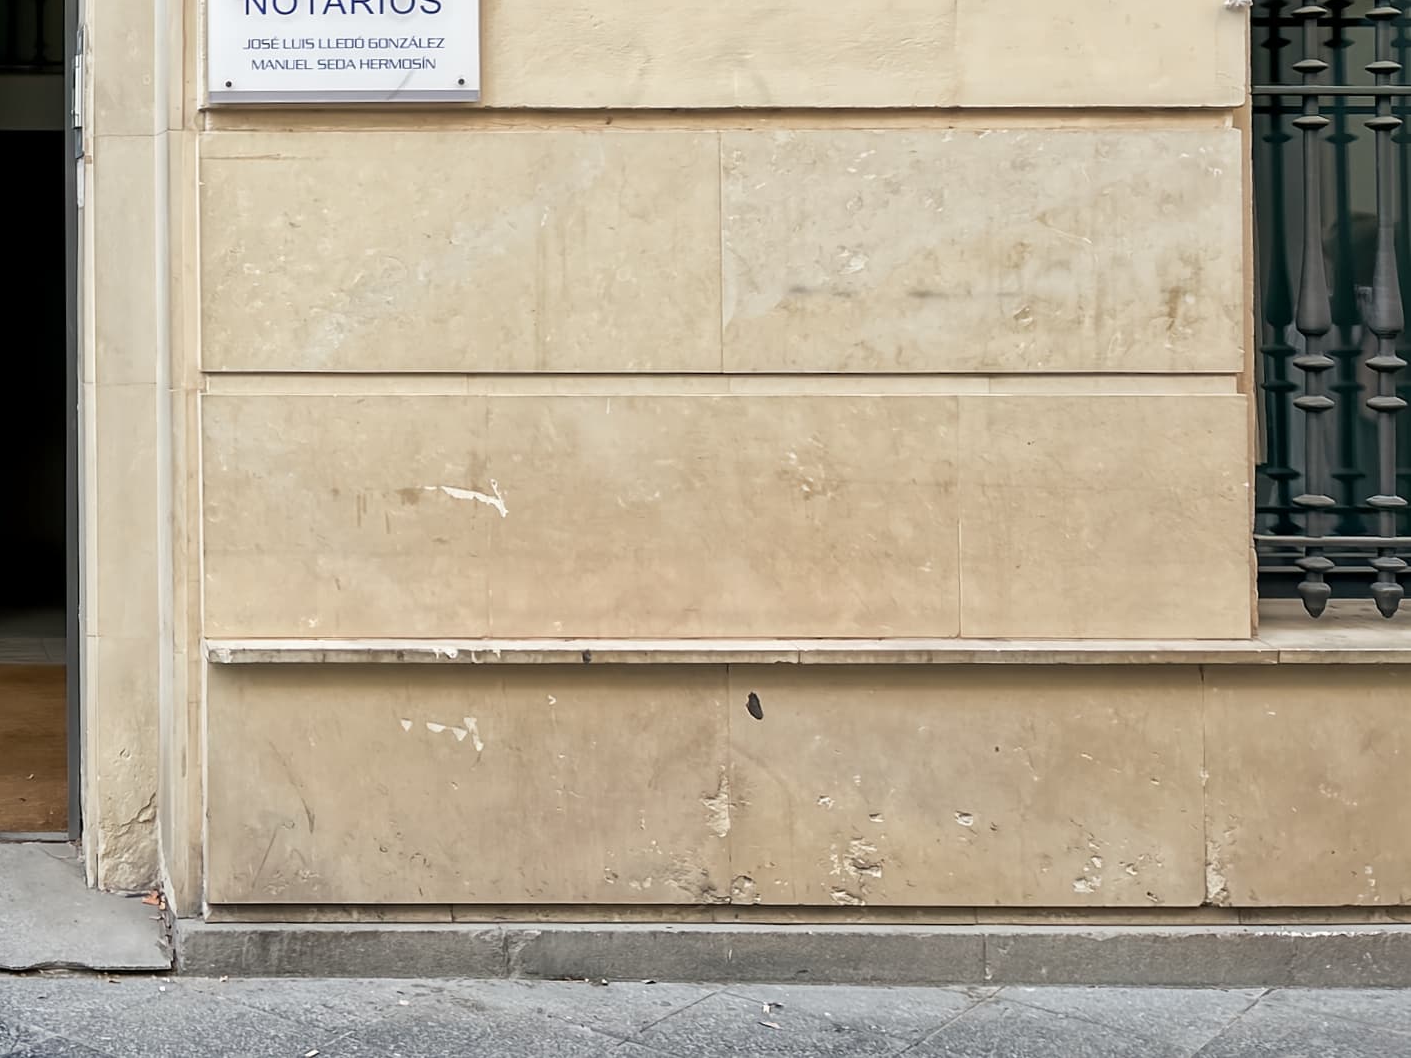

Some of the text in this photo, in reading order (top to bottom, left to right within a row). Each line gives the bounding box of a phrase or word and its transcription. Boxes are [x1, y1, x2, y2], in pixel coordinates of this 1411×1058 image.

[243, 35, 445, 50] JOSÉ LUIS LLEDÓ GONZÁLEZ
[251, 56, 437, 70] MANUEL SEDA HERMOSÍN
